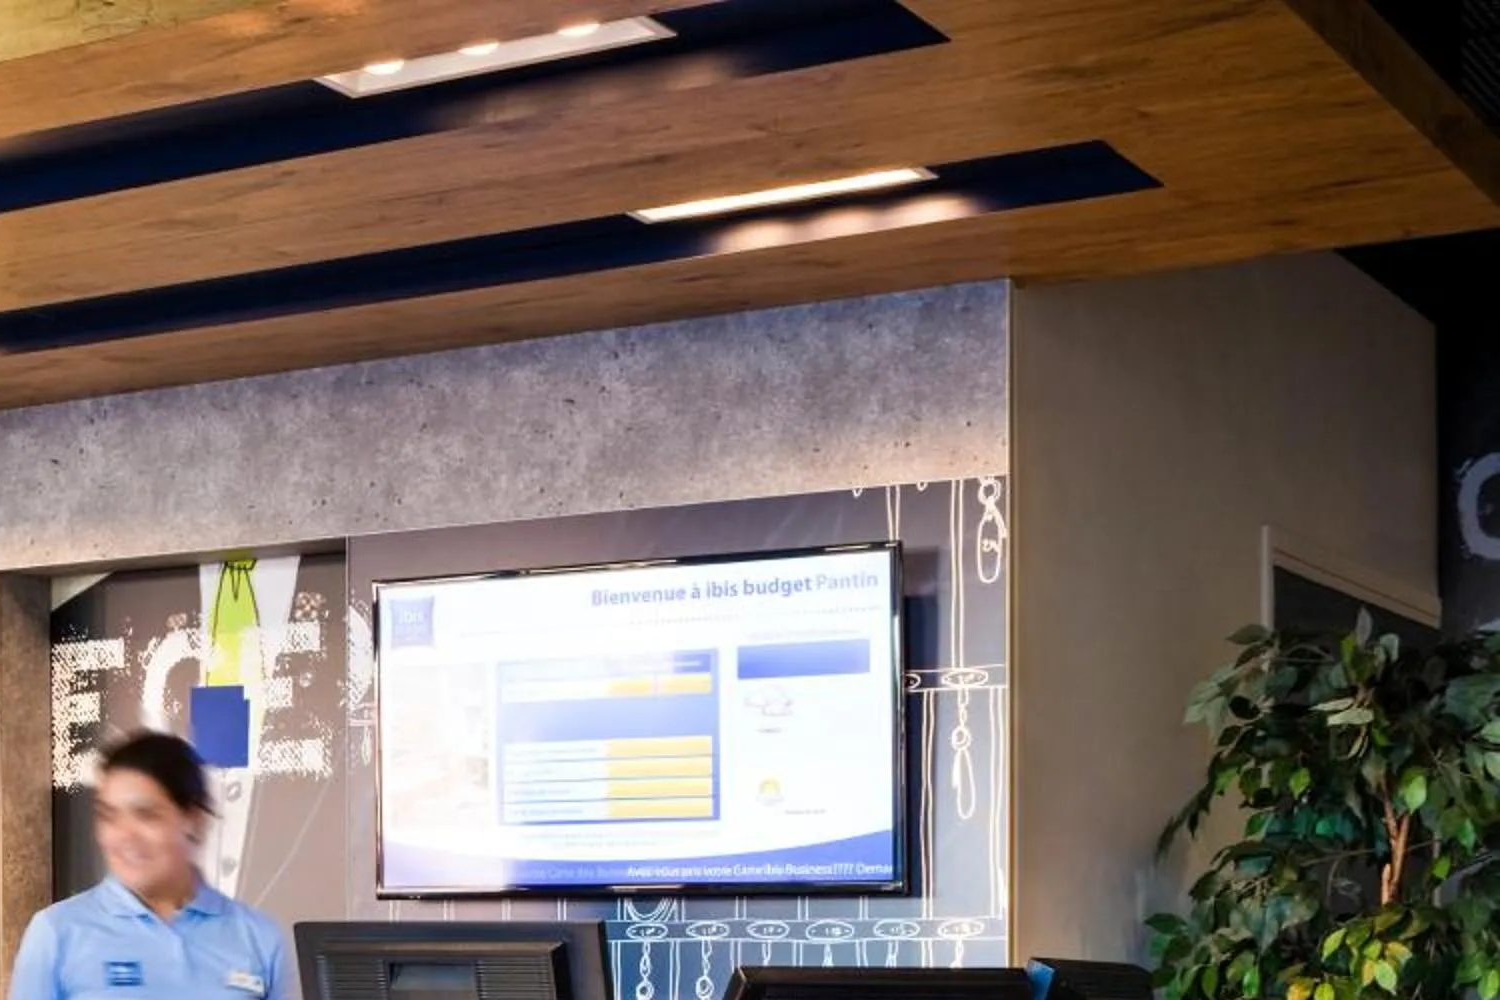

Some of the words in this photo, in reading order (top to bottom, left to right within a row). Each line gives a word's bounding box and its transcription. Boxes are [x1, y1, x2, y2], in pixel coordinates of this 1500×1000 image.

[591, 586, 686, 607] Bienvenue
[690, 581, 702, 600] à
[705, 578, 739, 599] ibis
[742, 575, 813, 598] budget
[816, 571, 880, 591] Pantin
